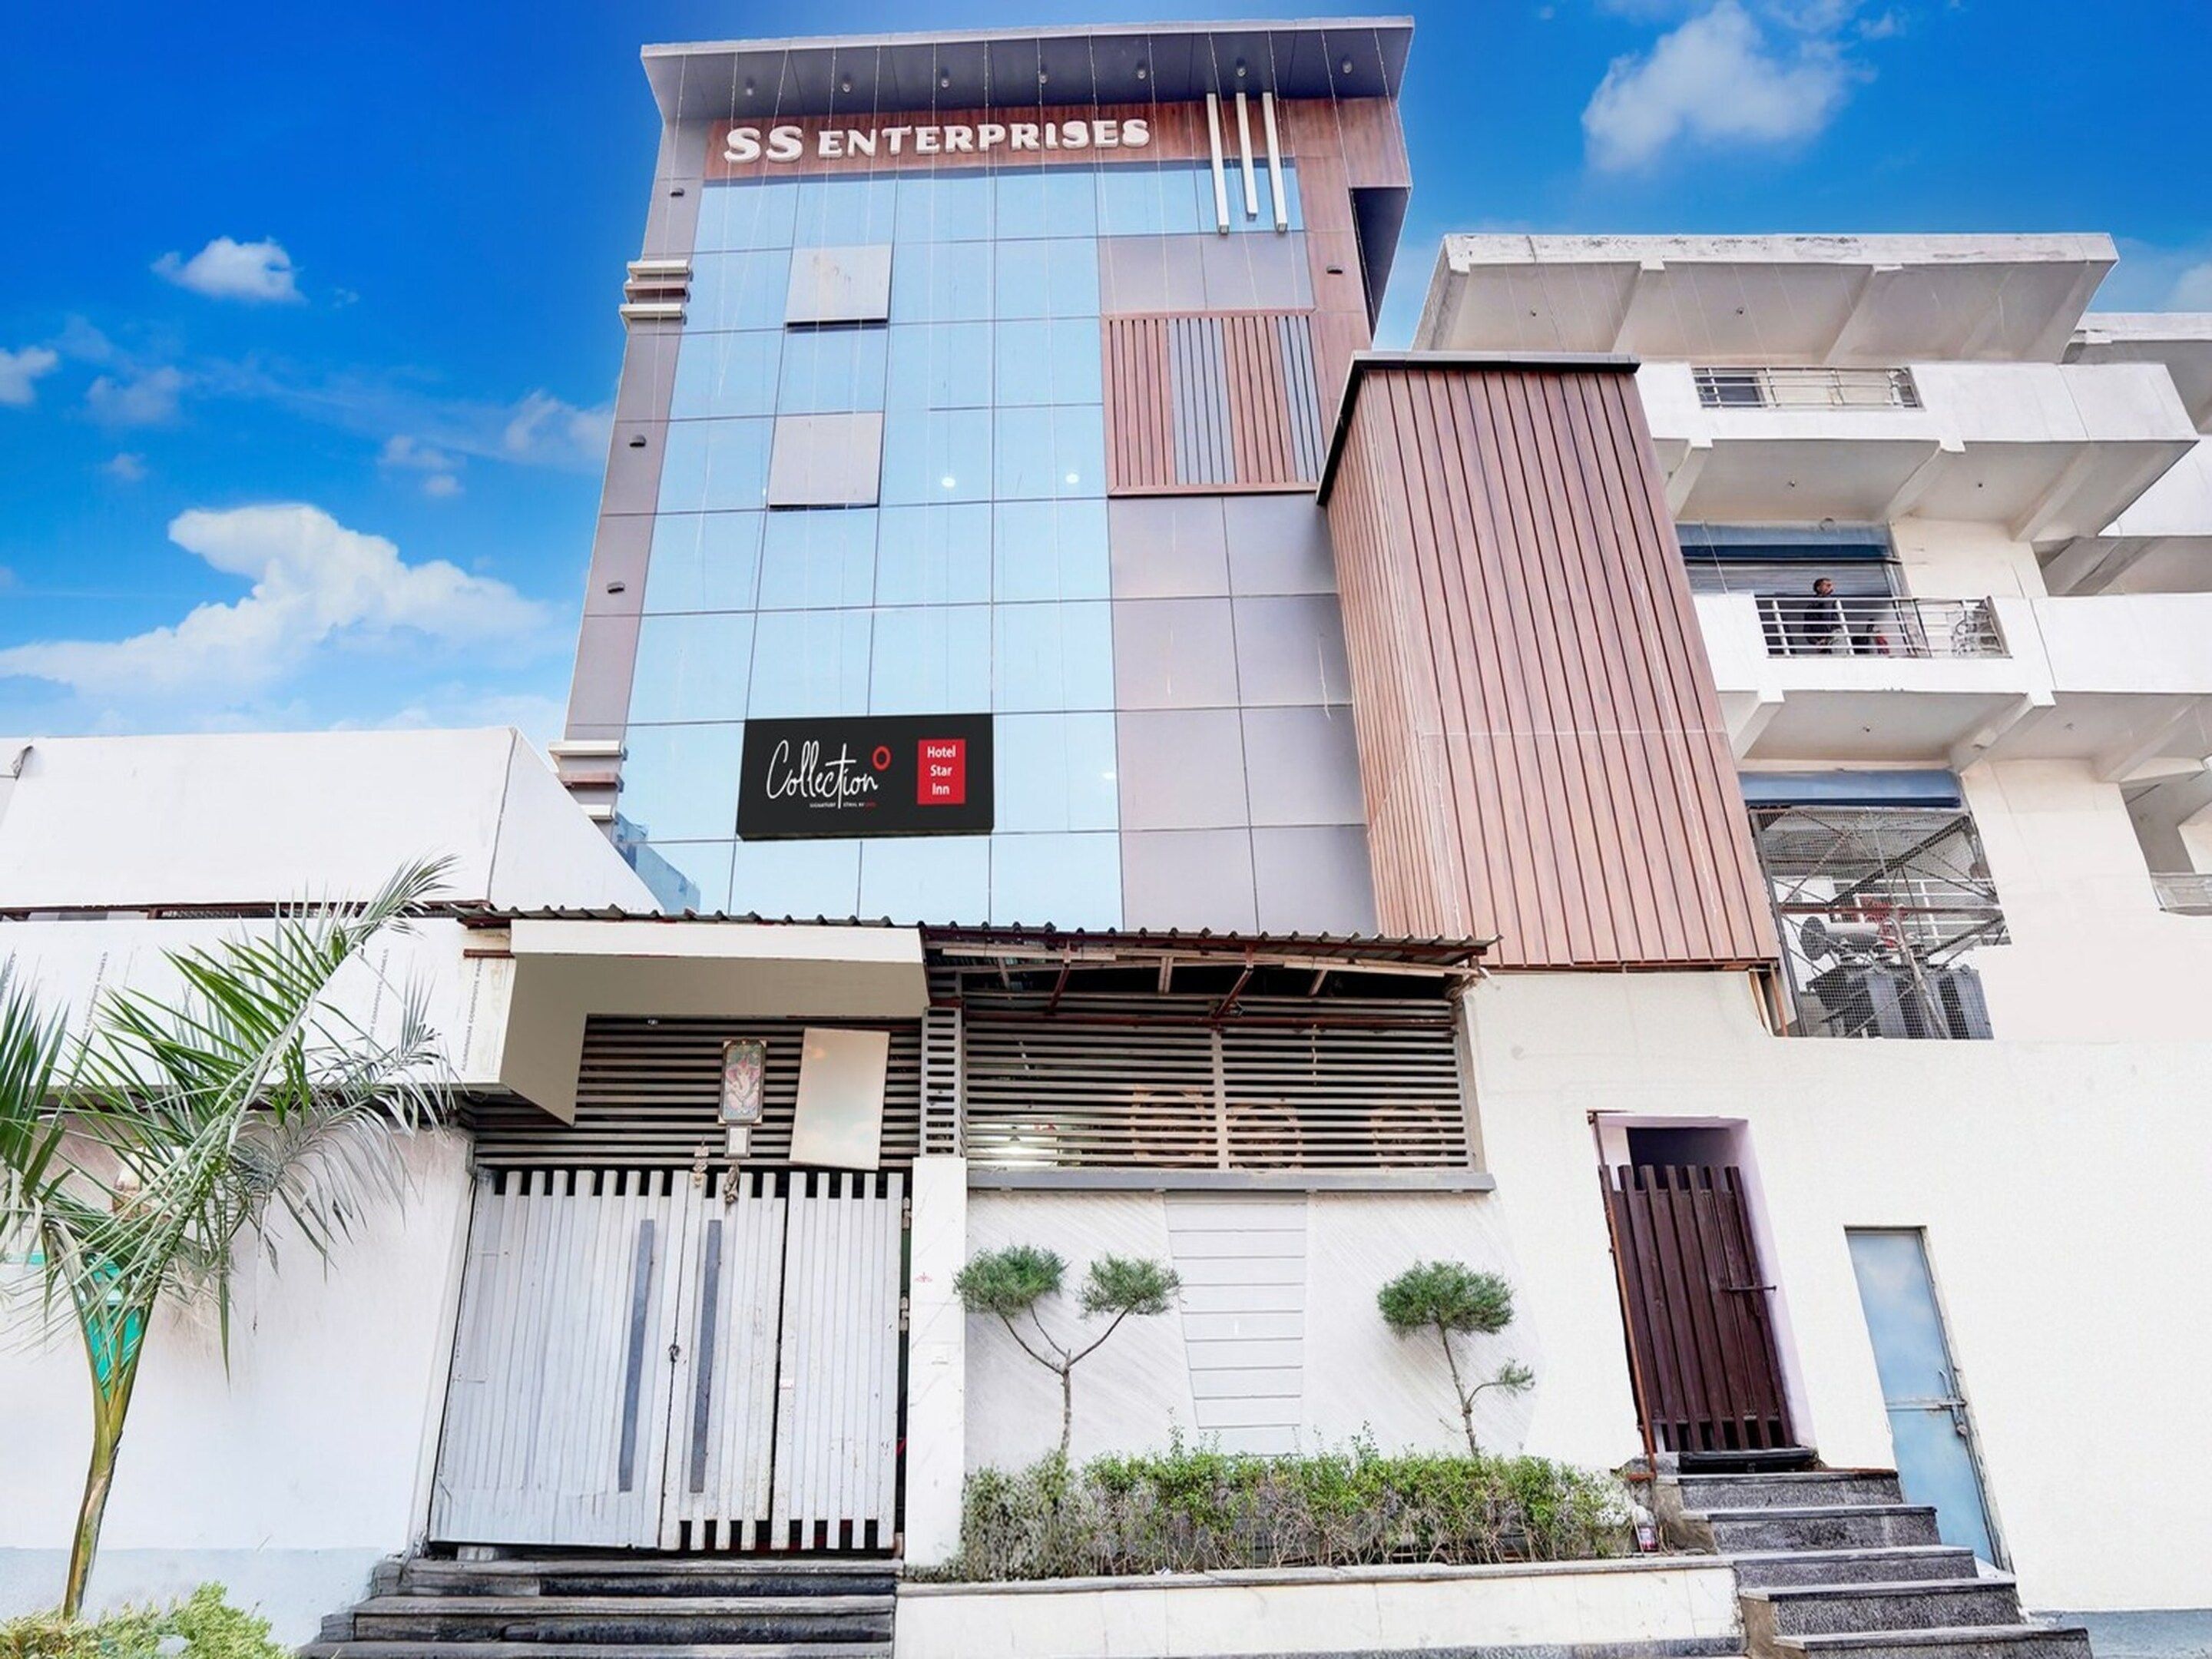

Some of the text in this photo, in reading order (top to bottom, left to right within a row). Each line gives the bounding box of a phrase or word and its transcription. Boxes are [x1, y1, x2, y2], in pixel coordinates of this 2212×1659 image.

[724, 119, 1150, 163] SS ENTERPRISES
[927, 744, 956, 758] Hotel
[766, 740, 878, 809] Collection
[930, 764, 952, 777] Star
[932, 783, 950, 795] Inn
